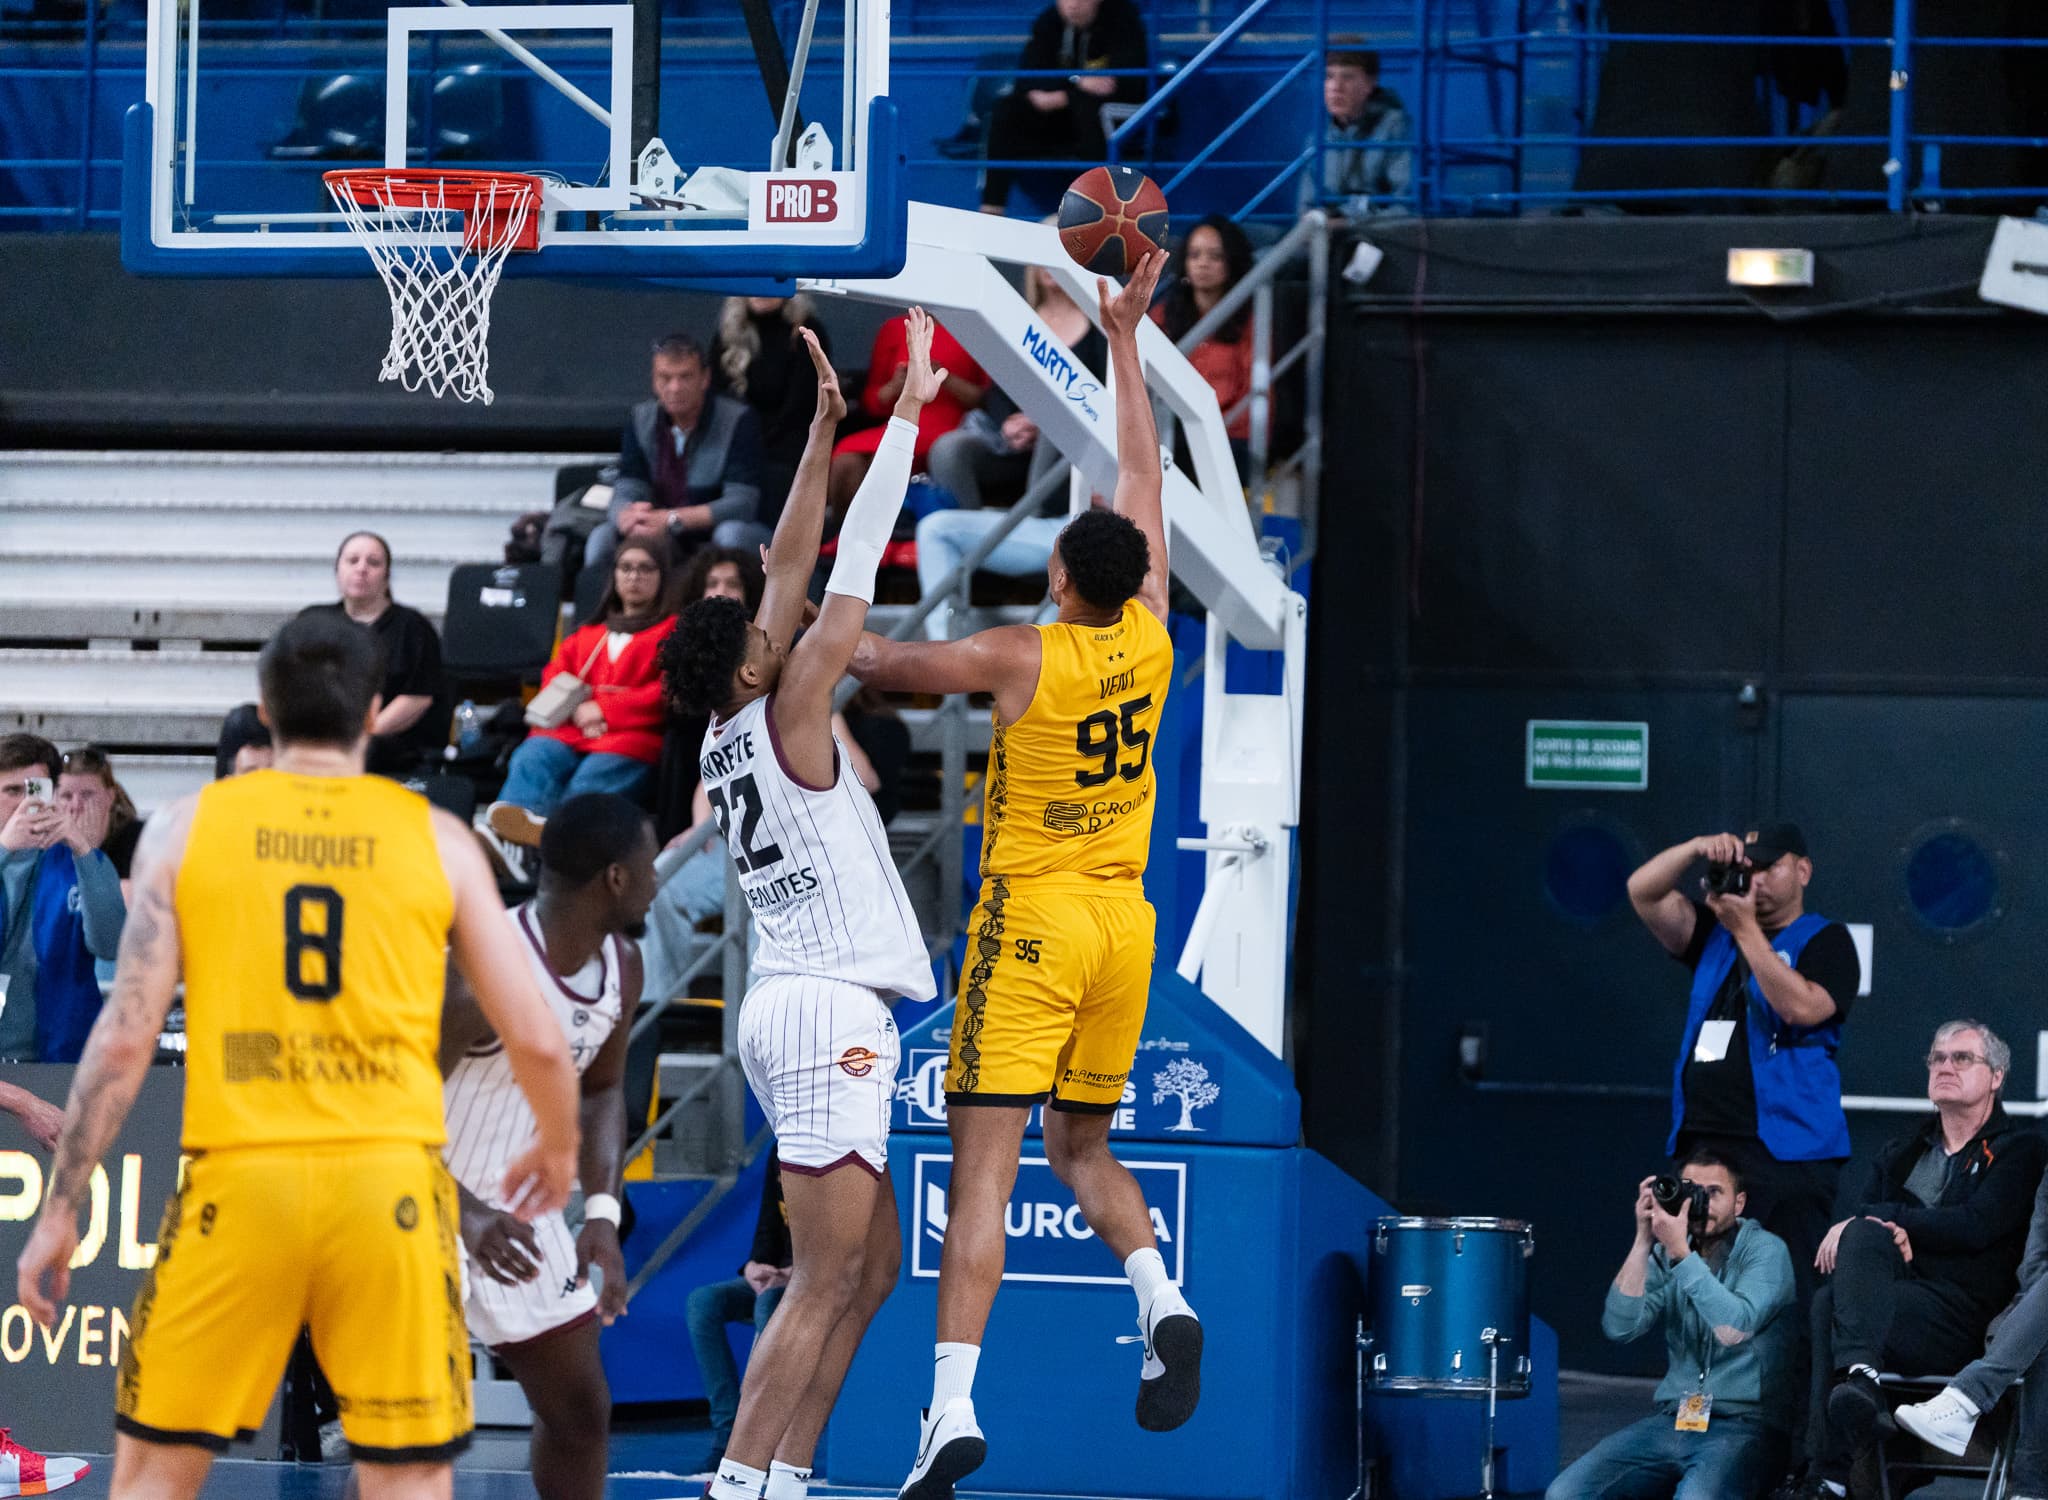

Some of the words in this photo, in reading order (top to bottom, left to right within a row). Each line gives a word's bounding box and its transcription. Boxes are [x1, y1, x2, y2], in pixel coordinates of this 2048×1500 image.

[1022, 324, 1079, 391] MARTY
[1100, 665, 1137, 700] VENT
[1075, 693, 1153, 788] 95
[256, 828, 376, 870] BOUQUET
[285, 883, 344, 1005] 8
[1014, 938, 1042, 964] 95
